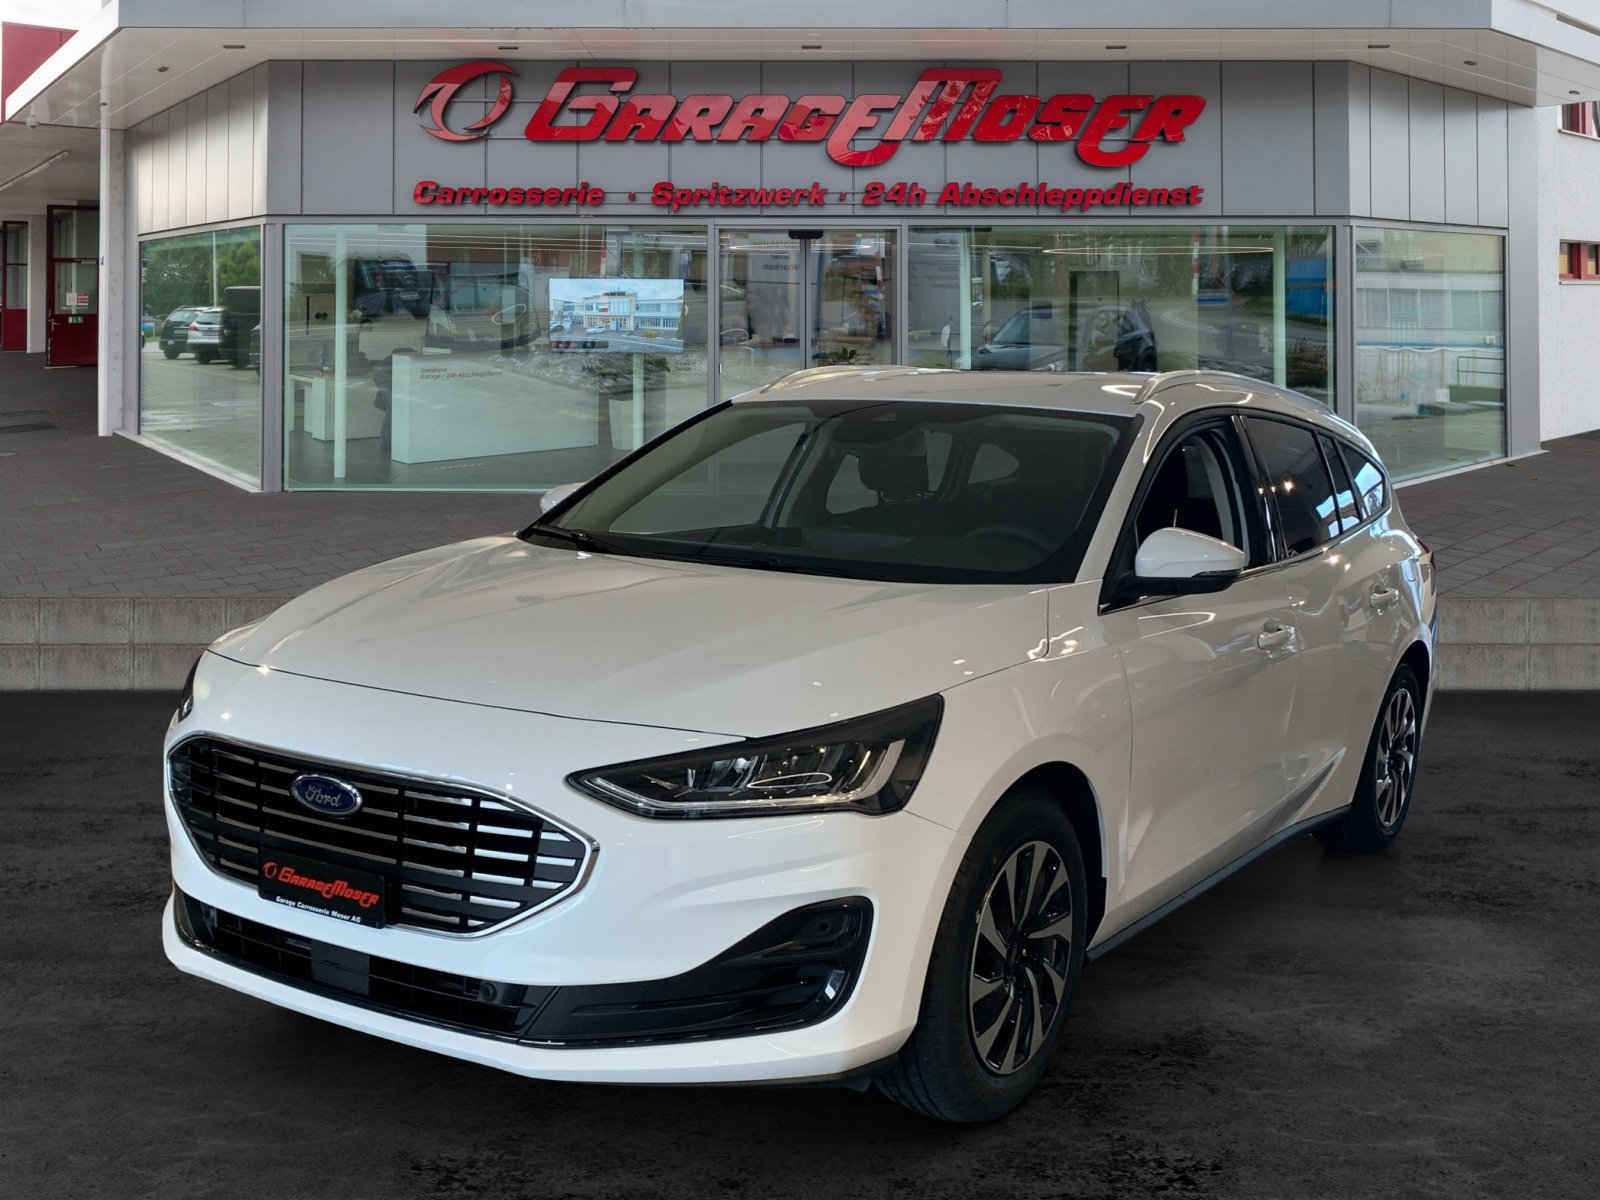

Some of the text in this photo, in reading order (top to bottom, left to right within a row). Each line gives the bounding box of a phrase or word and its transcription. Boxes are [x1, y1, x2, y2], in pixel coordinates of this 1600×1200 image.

[413, 181, 1205, 212] Carrosserie Spritzwerk 24h Abschleppdienst
[305, 786, 343, 807] Ford
[276, 896, 362, 924] Garage Carrosserie Moser AG
